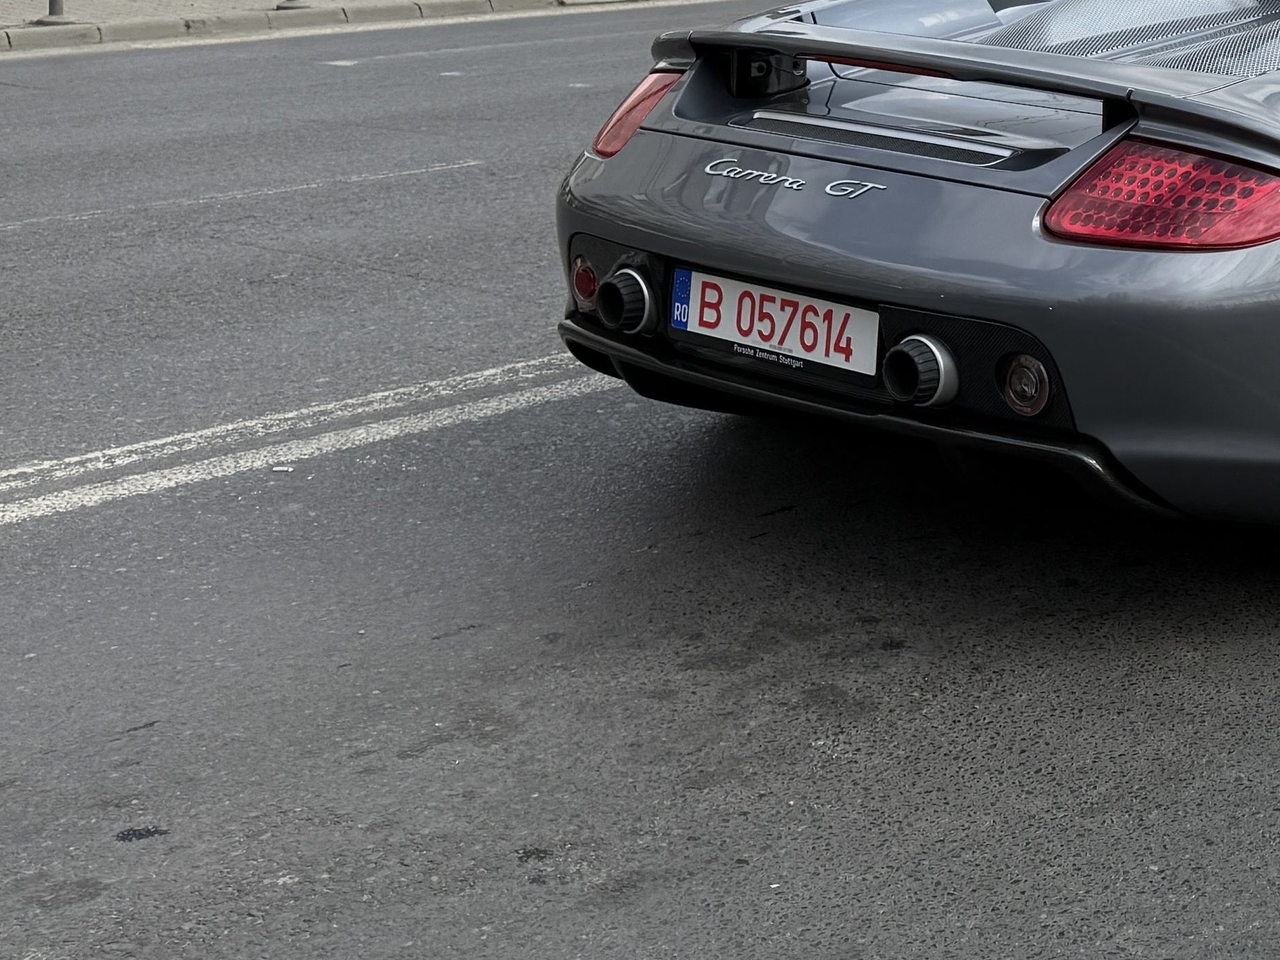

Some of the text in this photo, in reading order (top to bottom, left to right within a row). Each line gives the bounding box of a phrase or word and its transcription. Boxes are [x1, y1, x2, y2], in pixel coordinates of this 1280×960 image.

[705, 158, 887, 199] Carrera GT
[674, 302, 688, 322] RO
[698, 280, 853, 363] B 057614
[734, 344, 754, 356] Porsche
[756, 348, 778, 362] Zentrum
[779, 354, 803, 368] Stuttgart
